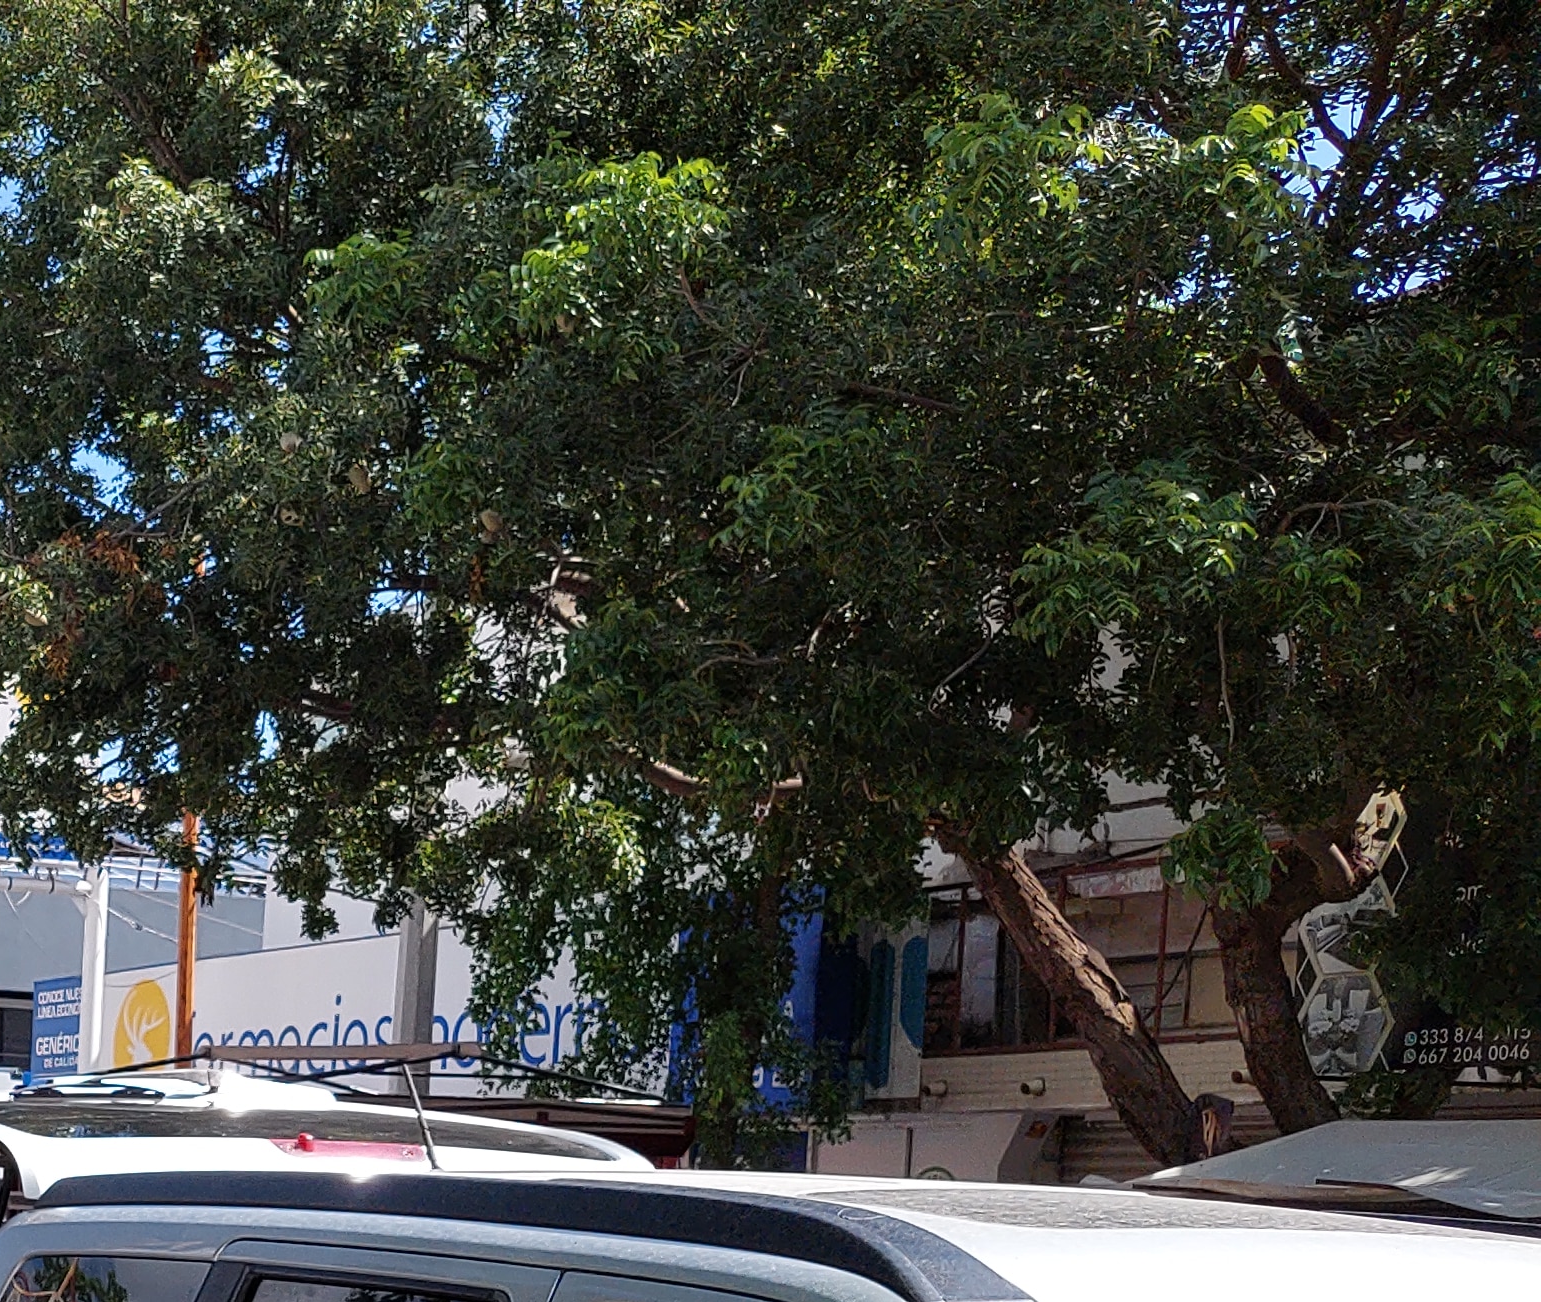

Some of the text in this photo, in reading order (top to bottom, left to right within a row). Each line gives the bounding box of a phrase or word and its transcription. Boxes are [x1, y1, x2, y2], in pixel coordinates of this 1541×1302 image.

[191, 994, 394, 1078] armacias
[1419, 1028, 1449, 1045] 333
[1418, 1043, 1530, 1065] 667 204 0046
